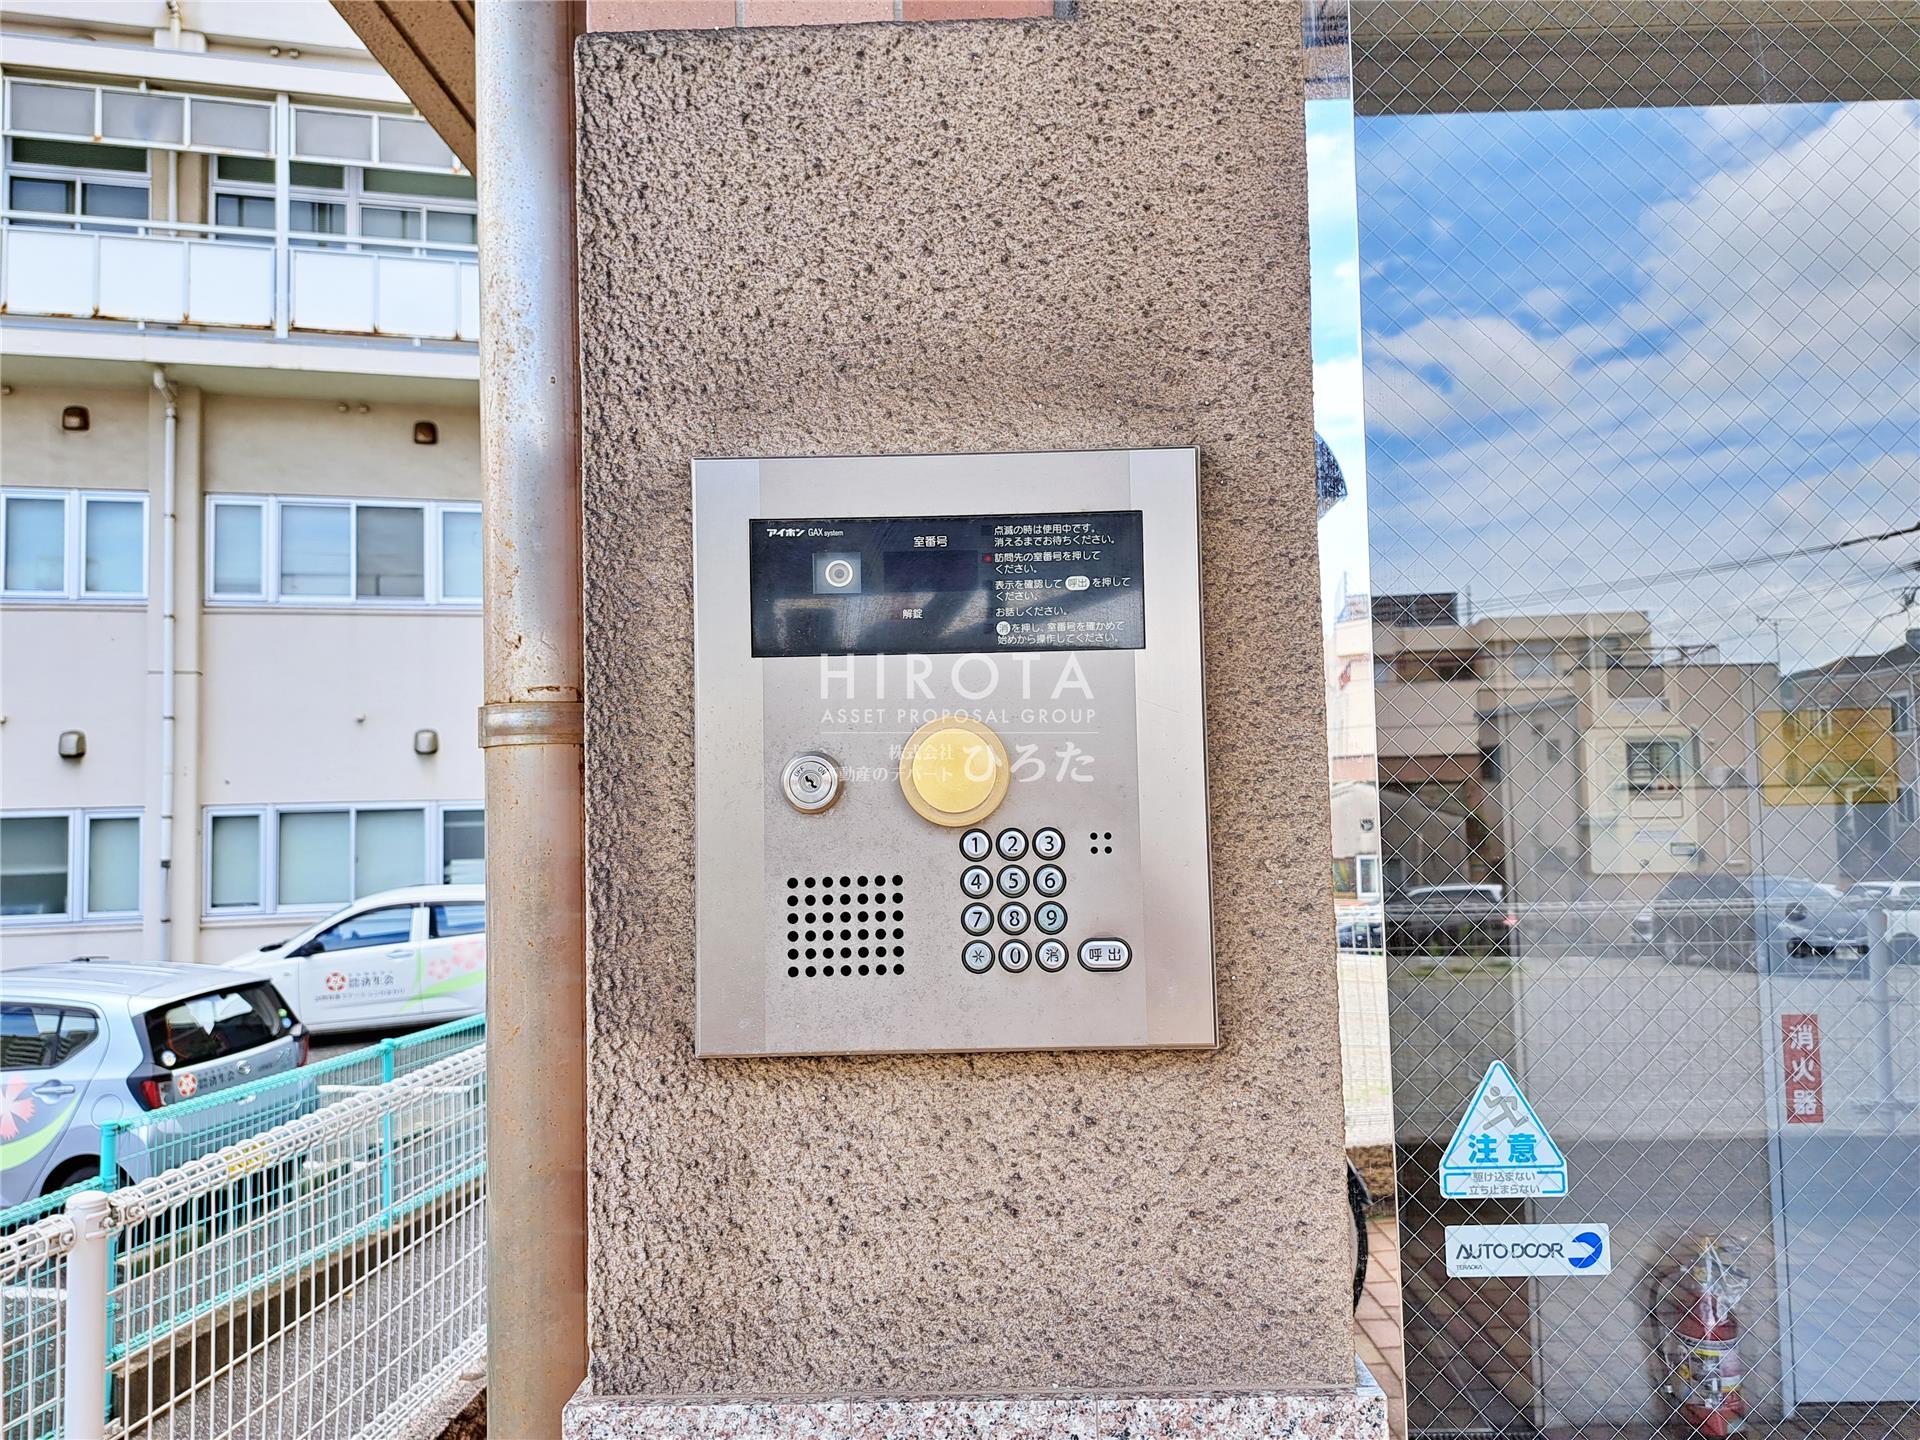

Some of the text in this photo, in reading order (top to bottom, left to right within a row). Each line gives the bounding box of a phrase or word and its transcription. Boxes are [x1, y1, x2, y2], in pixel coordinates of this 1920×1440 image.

[766, 528, 844, 538] アイホン GAX system
[913, 535, 949, 548] 室番号
[994, 535, 1115, 548] 消えるまでお待ちください。
[994, 551, 1101, 563] 訪問先の室番号を押して
[995, 564, 1038, 575] ください。
[996, 591, 1039, 602] ください。
[902, 609, 923, 620] 解錠
[995, 606, 1068, 618] お話しください。
[997, 633, 1119, 646] 始めから操作してください。
[971, 835, 1055, 853] 1 2 3
[970, 872, 1056, 890] 4 5 6
[972, 909, 1057, 928] 7 8 9
[1009, 947, 1121, 965] 0 消 呼出
[1789, 1024, 1817, 1115] 消火器
[1468, 1133, 1538, 1164] 注意
[1473, 1171, 1536, 1183] 駆け込まない
[1469, 1184, 1541, 1196] 立ち止まらない
[1455, 1242, 1565, 1260] AUTO DOOR
